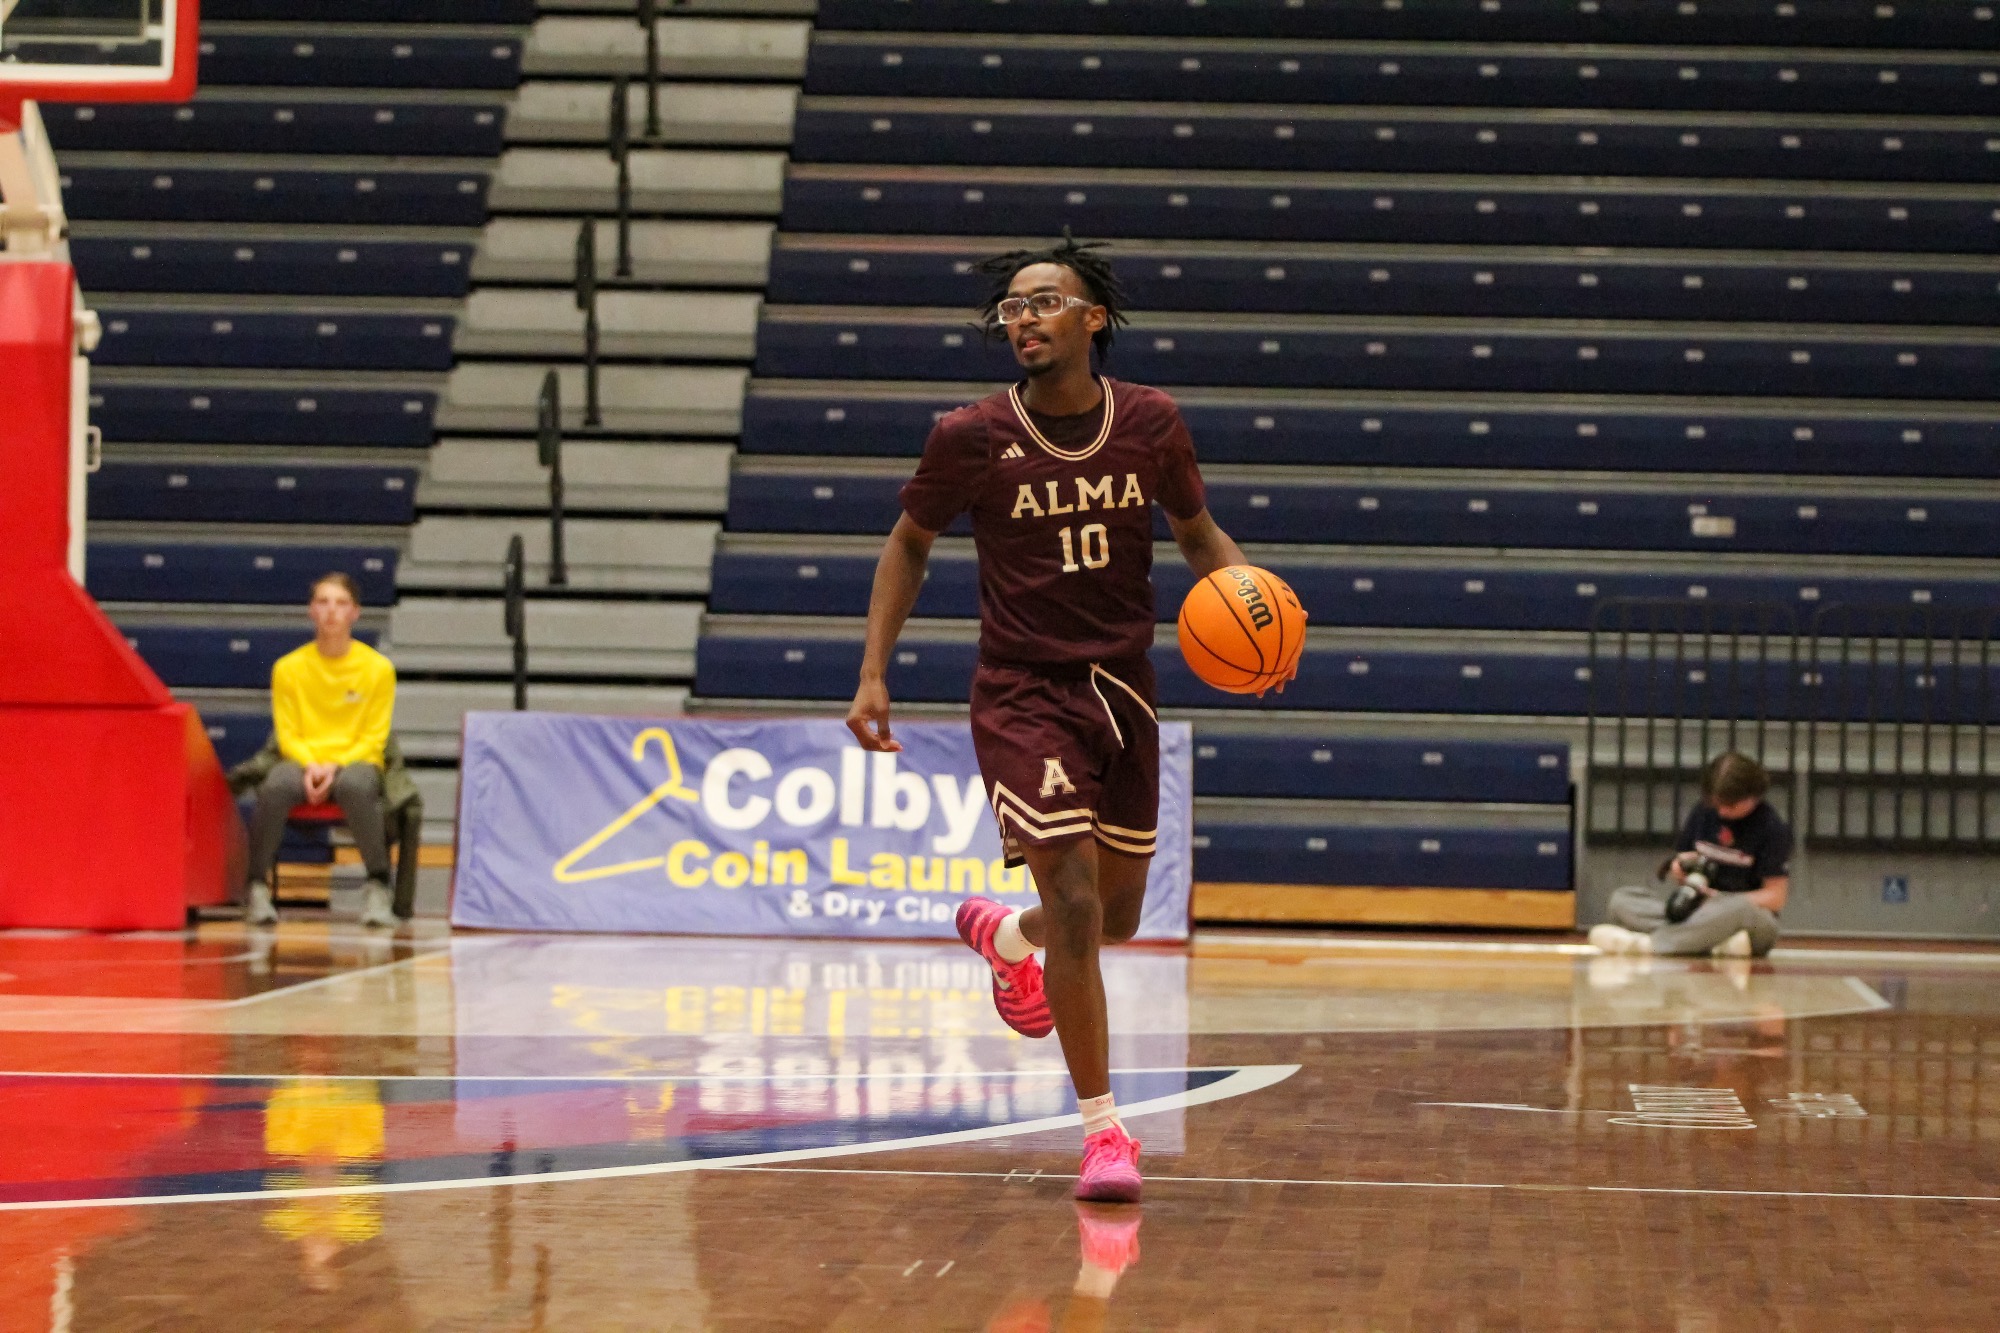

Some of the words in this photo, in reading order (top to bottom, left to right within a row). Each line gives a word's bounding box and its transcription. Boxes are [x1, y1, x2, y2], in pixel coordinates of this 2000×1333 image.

[1011, 473, 1145, 518] ALMA
[1059, 523, 1110, 573] 10
[702, 745, 988, 854] Colby
[1039, 757, 1077, 798] A
[667, 838, 808, 889] Coin
[788, 889, 814, 919] &
[822, 890, 887, 926] Dry
